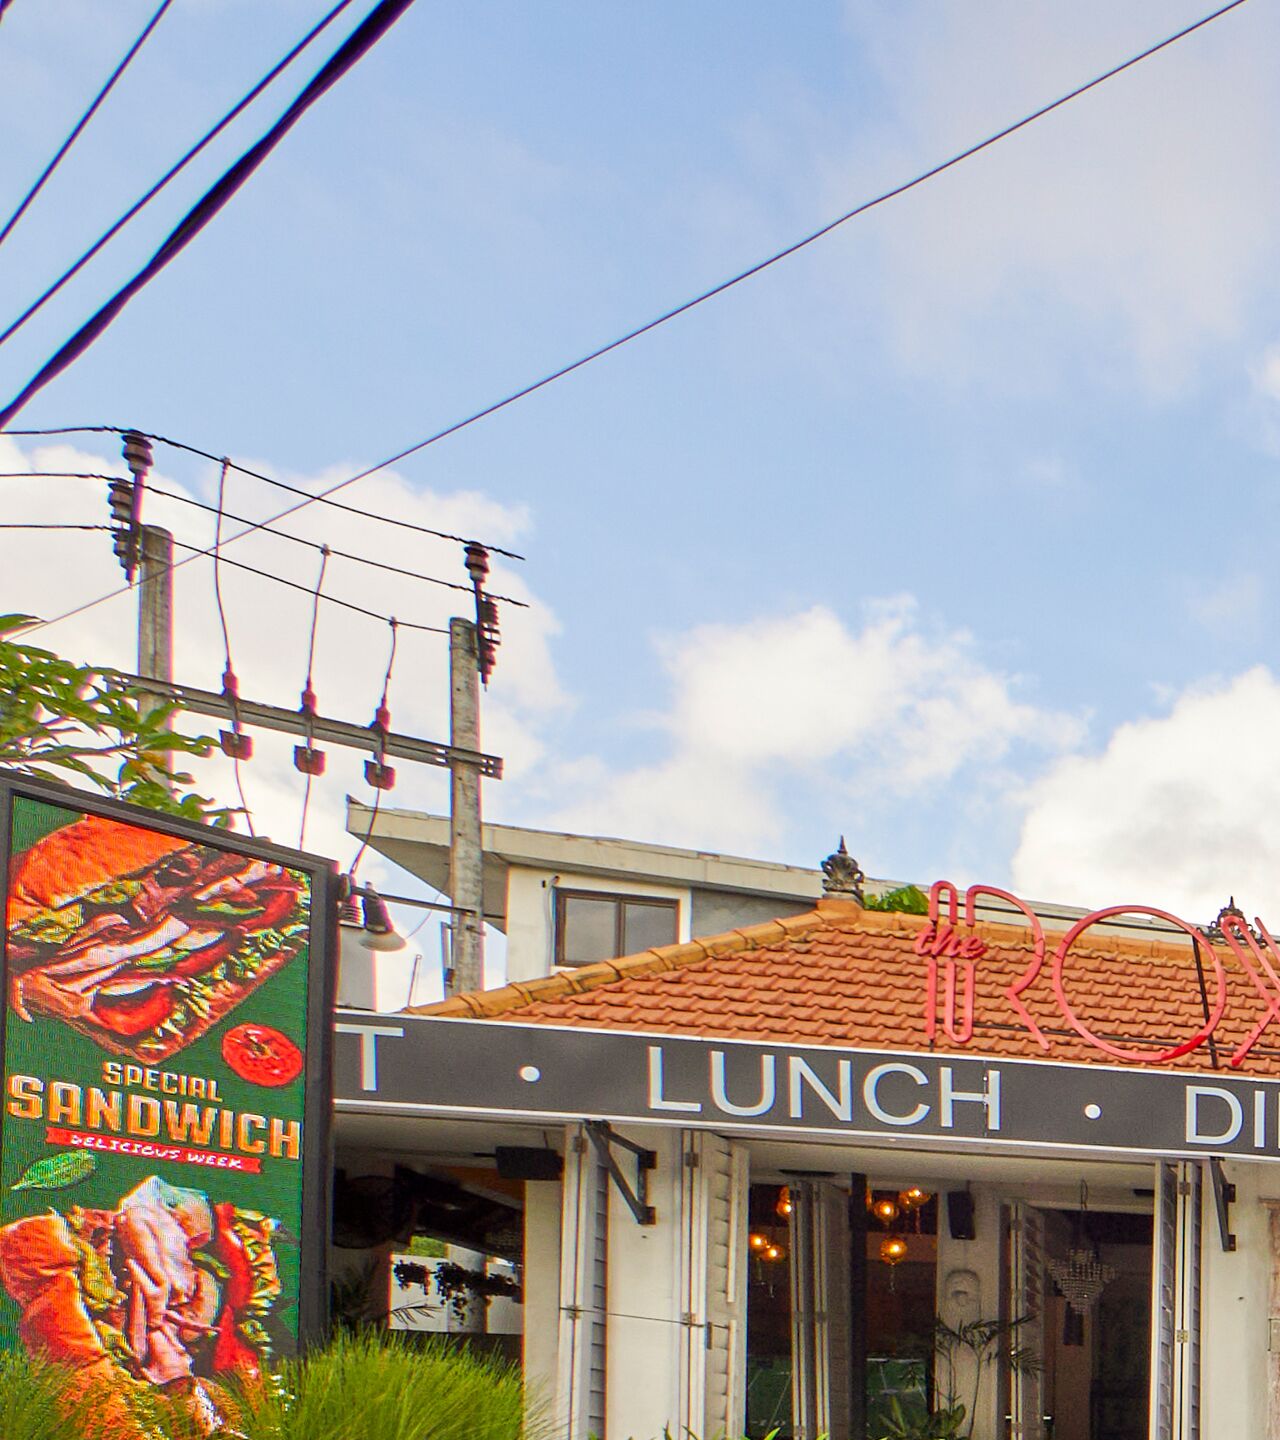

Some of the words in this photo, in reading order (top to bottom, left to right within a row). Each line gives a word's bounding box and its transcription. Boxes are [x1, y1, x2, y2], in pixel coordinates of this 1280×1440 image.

[913, 923, 987, 957] the
[103, 1061, 223, 1103] SPECIAL
[648, 1045, 1001, 1130] LUNCH
[7, 1074, 301, 1160] SANDWICH
[70, 1133, 181, 1160] DELICIOUS
[186, 1151, 243, 1170] WEEK
